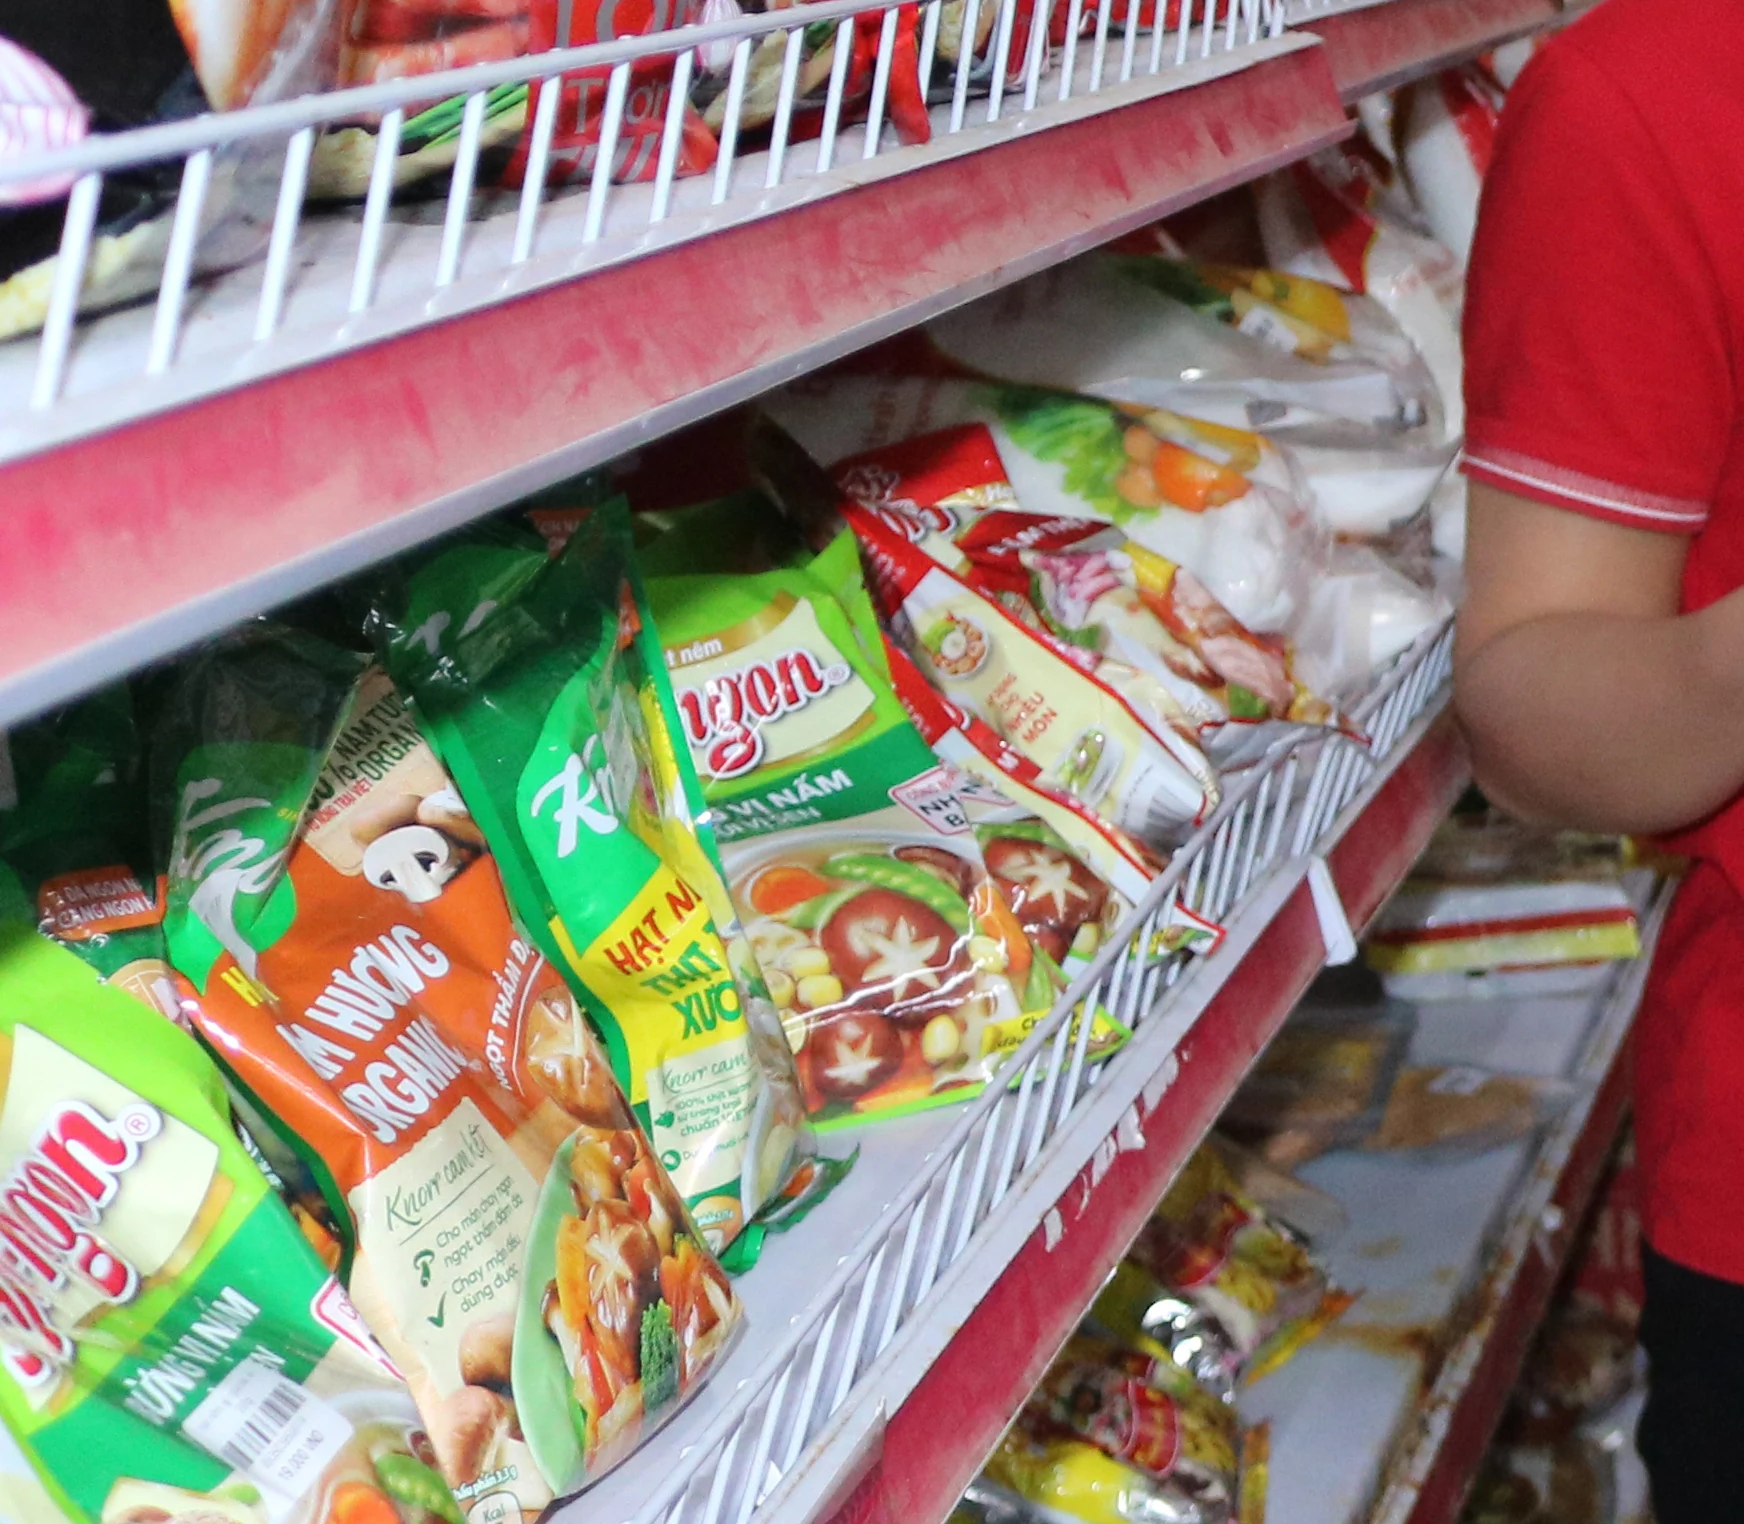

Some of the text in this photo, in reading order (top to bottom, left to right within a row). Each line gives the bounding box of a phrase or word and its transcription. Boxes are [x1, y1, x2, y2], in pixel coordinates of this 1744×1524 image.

[679, 637, 723, 664] nêm
[603, 907, 670, 977] HẠT
[304, 923, 451, 1043] HƯƠNG
[384, 1173, 442, 1232] Knorr
[443, 1144, 476, 1185] cam
[436, 1224, 461, 1248] Cho
[442, 1239, 474, 1268] ngọt
[450, 1263, 485, 1296] Chay
